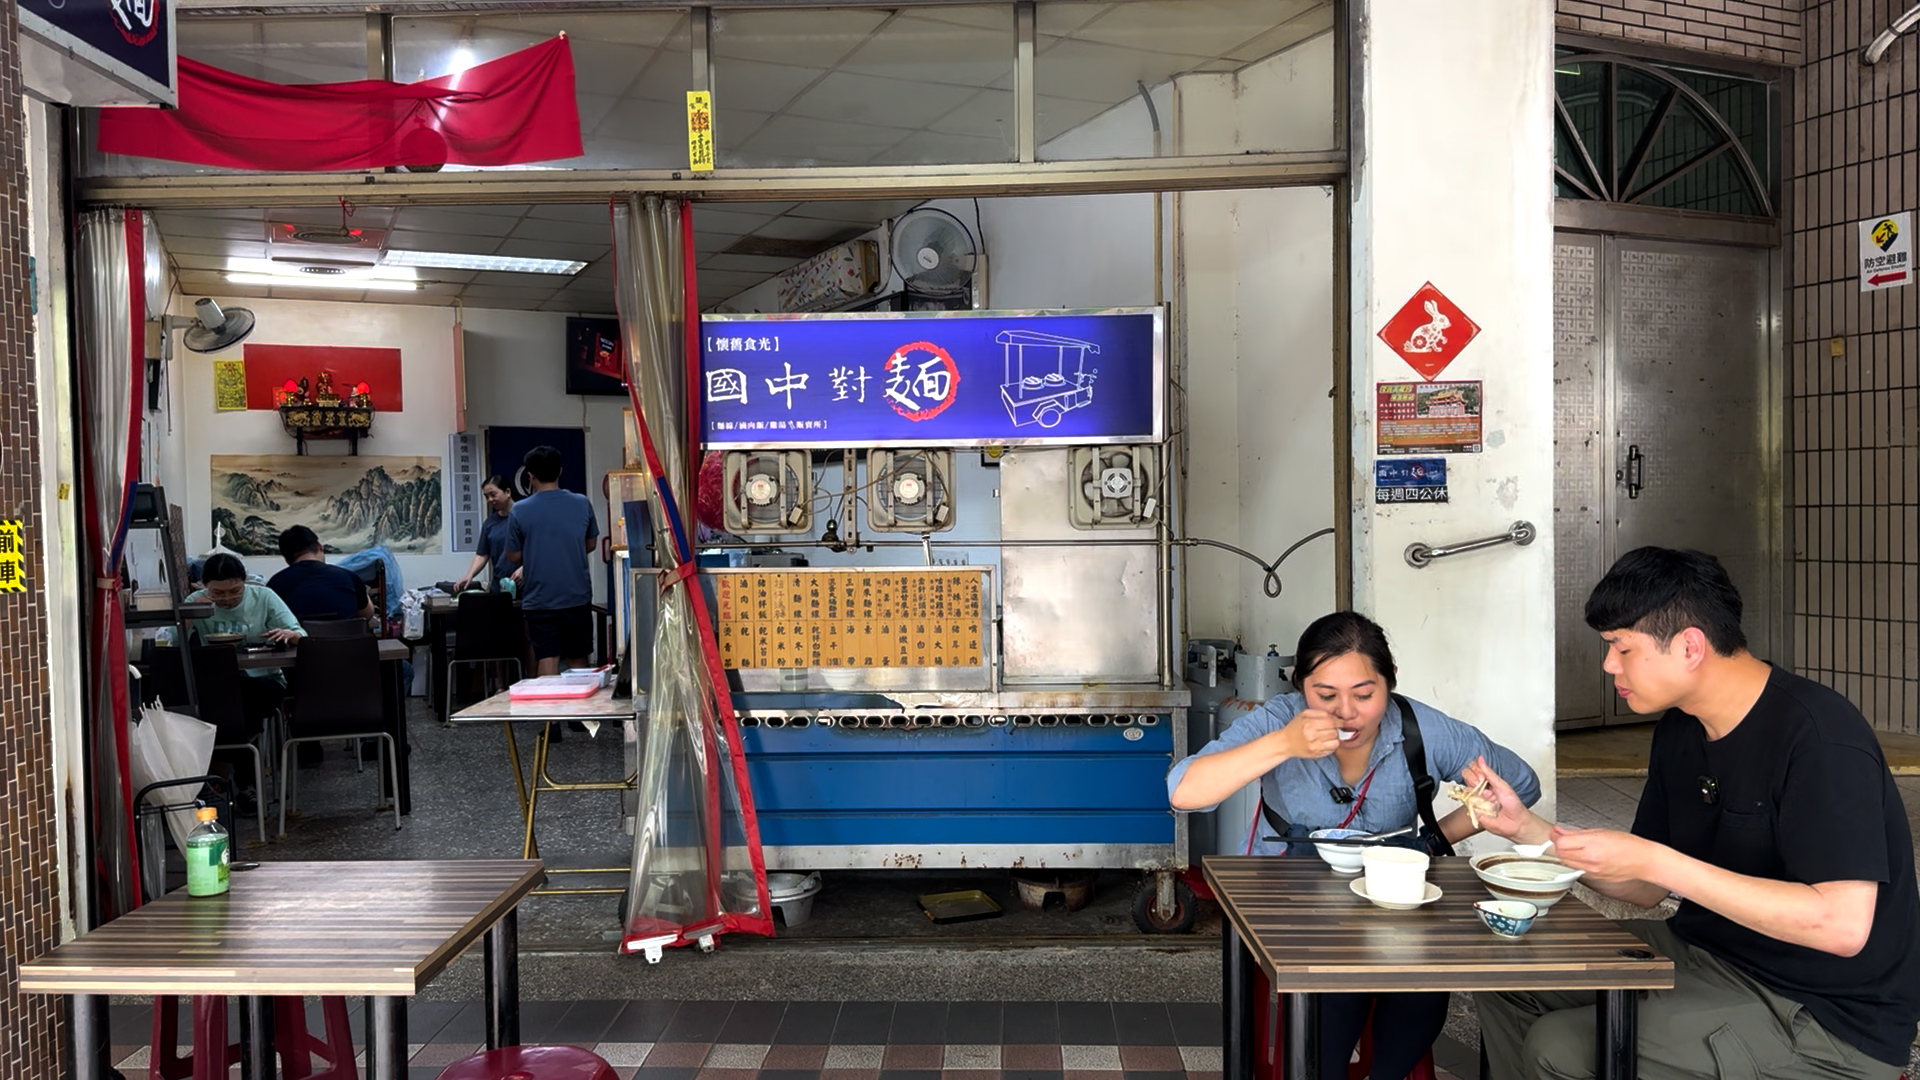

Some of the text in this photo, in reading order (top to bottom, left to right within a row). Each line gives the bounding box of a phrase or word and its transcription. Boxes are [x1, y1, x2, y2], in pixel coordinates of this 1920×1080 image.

[1864, 252, 1907, 269] 防空避難
[1376, 487, 1448, 502] 每週四公休
[739, 578, 749, 620] 滷肉飯
[757, 577, 768, 620] 豬油拌飯
[810, 577, 820, 619] 大腸麵線
[845, 577, 856, 618] 三寶麵線
[723, 626, 733, 668] 燙青菜
[758, 626, 768, 667] 乾米苔目
[776, 625, 787, 667] 乾米粉
[793, 625, 804, 667] 乾冬粉
[846, 625, 856, 666] 海帶
[881, 624, 891, 666] 滷蛋
[916, 624, 926, 666] 滷白菜
[933, 624, 943, 665] 滷大腸
